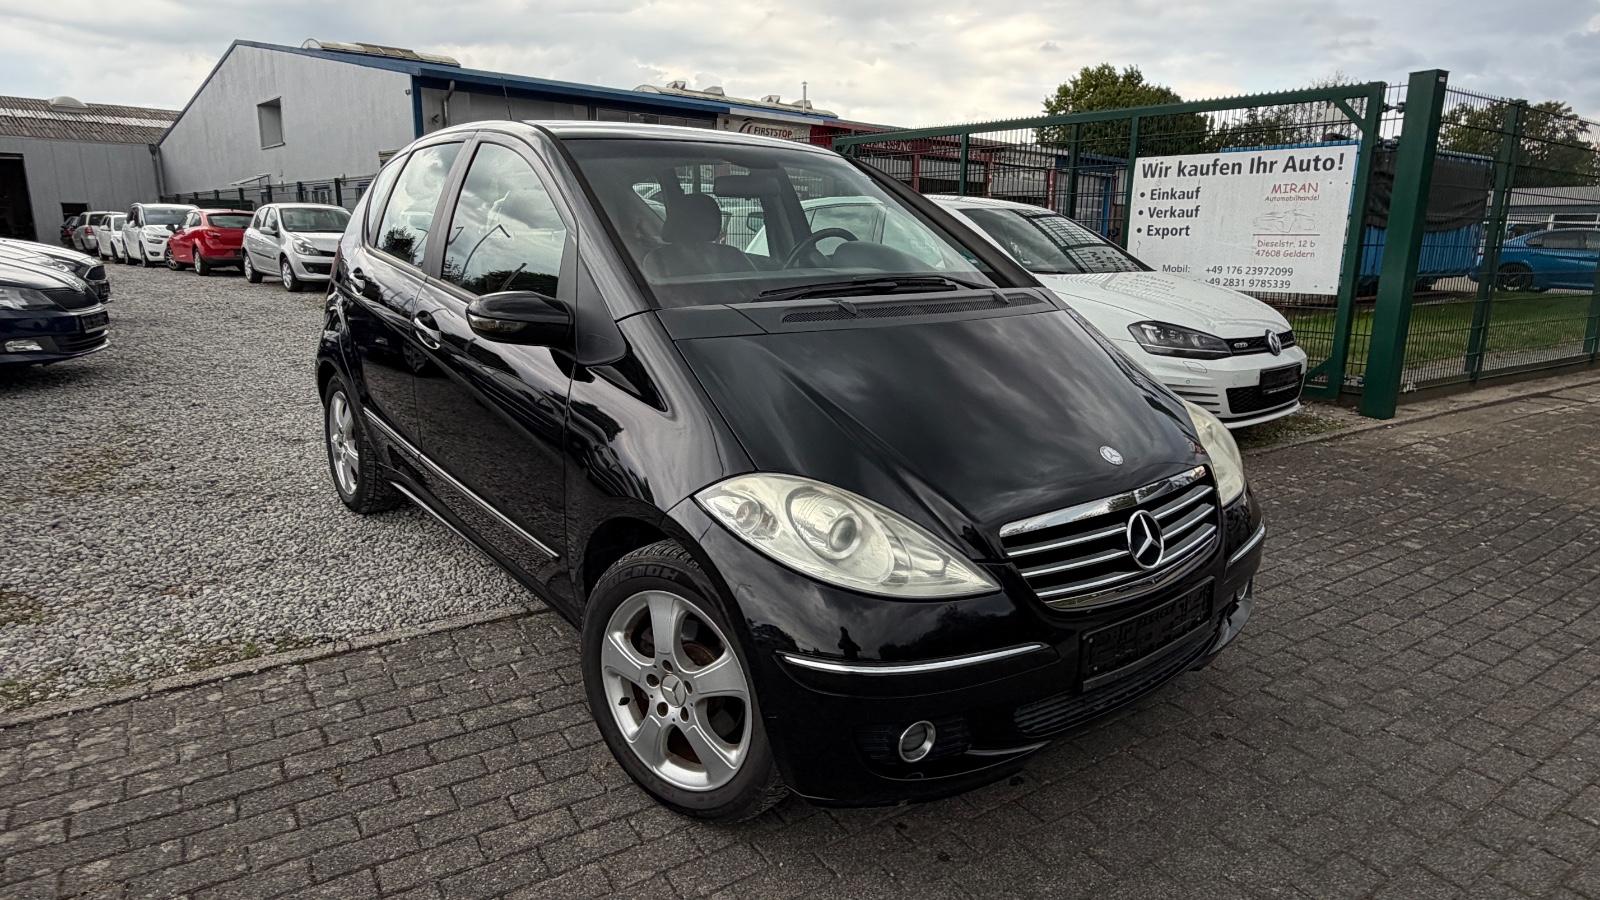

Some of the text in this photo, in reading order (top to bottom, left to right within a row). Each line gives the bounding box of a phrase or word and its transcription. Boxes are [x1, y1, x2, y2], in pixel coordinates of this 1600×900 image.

[754, 126, 793, 138] FIRSTSTOP
[1142, 153, 1345, 179] Wir kaufen Ihr Auto!
[1150, 186, 1201, 201] Einkauf
[1271, 182, 1319, 194] MIRAN
[1148, 205, 1201, 219] Verkauf
[1146, 224, 1191, 240] Export
[1257, 240, 1316, 248] Dieselstr. 12 b
[1255, 249, 1315, 258] 47608 Geldern
[1162, 264, 1294, 277] Mobil: +49 176 23972099
[1223, 278, 1245, 287] 2831
[1249, 279, 1291, 289] 9785339
